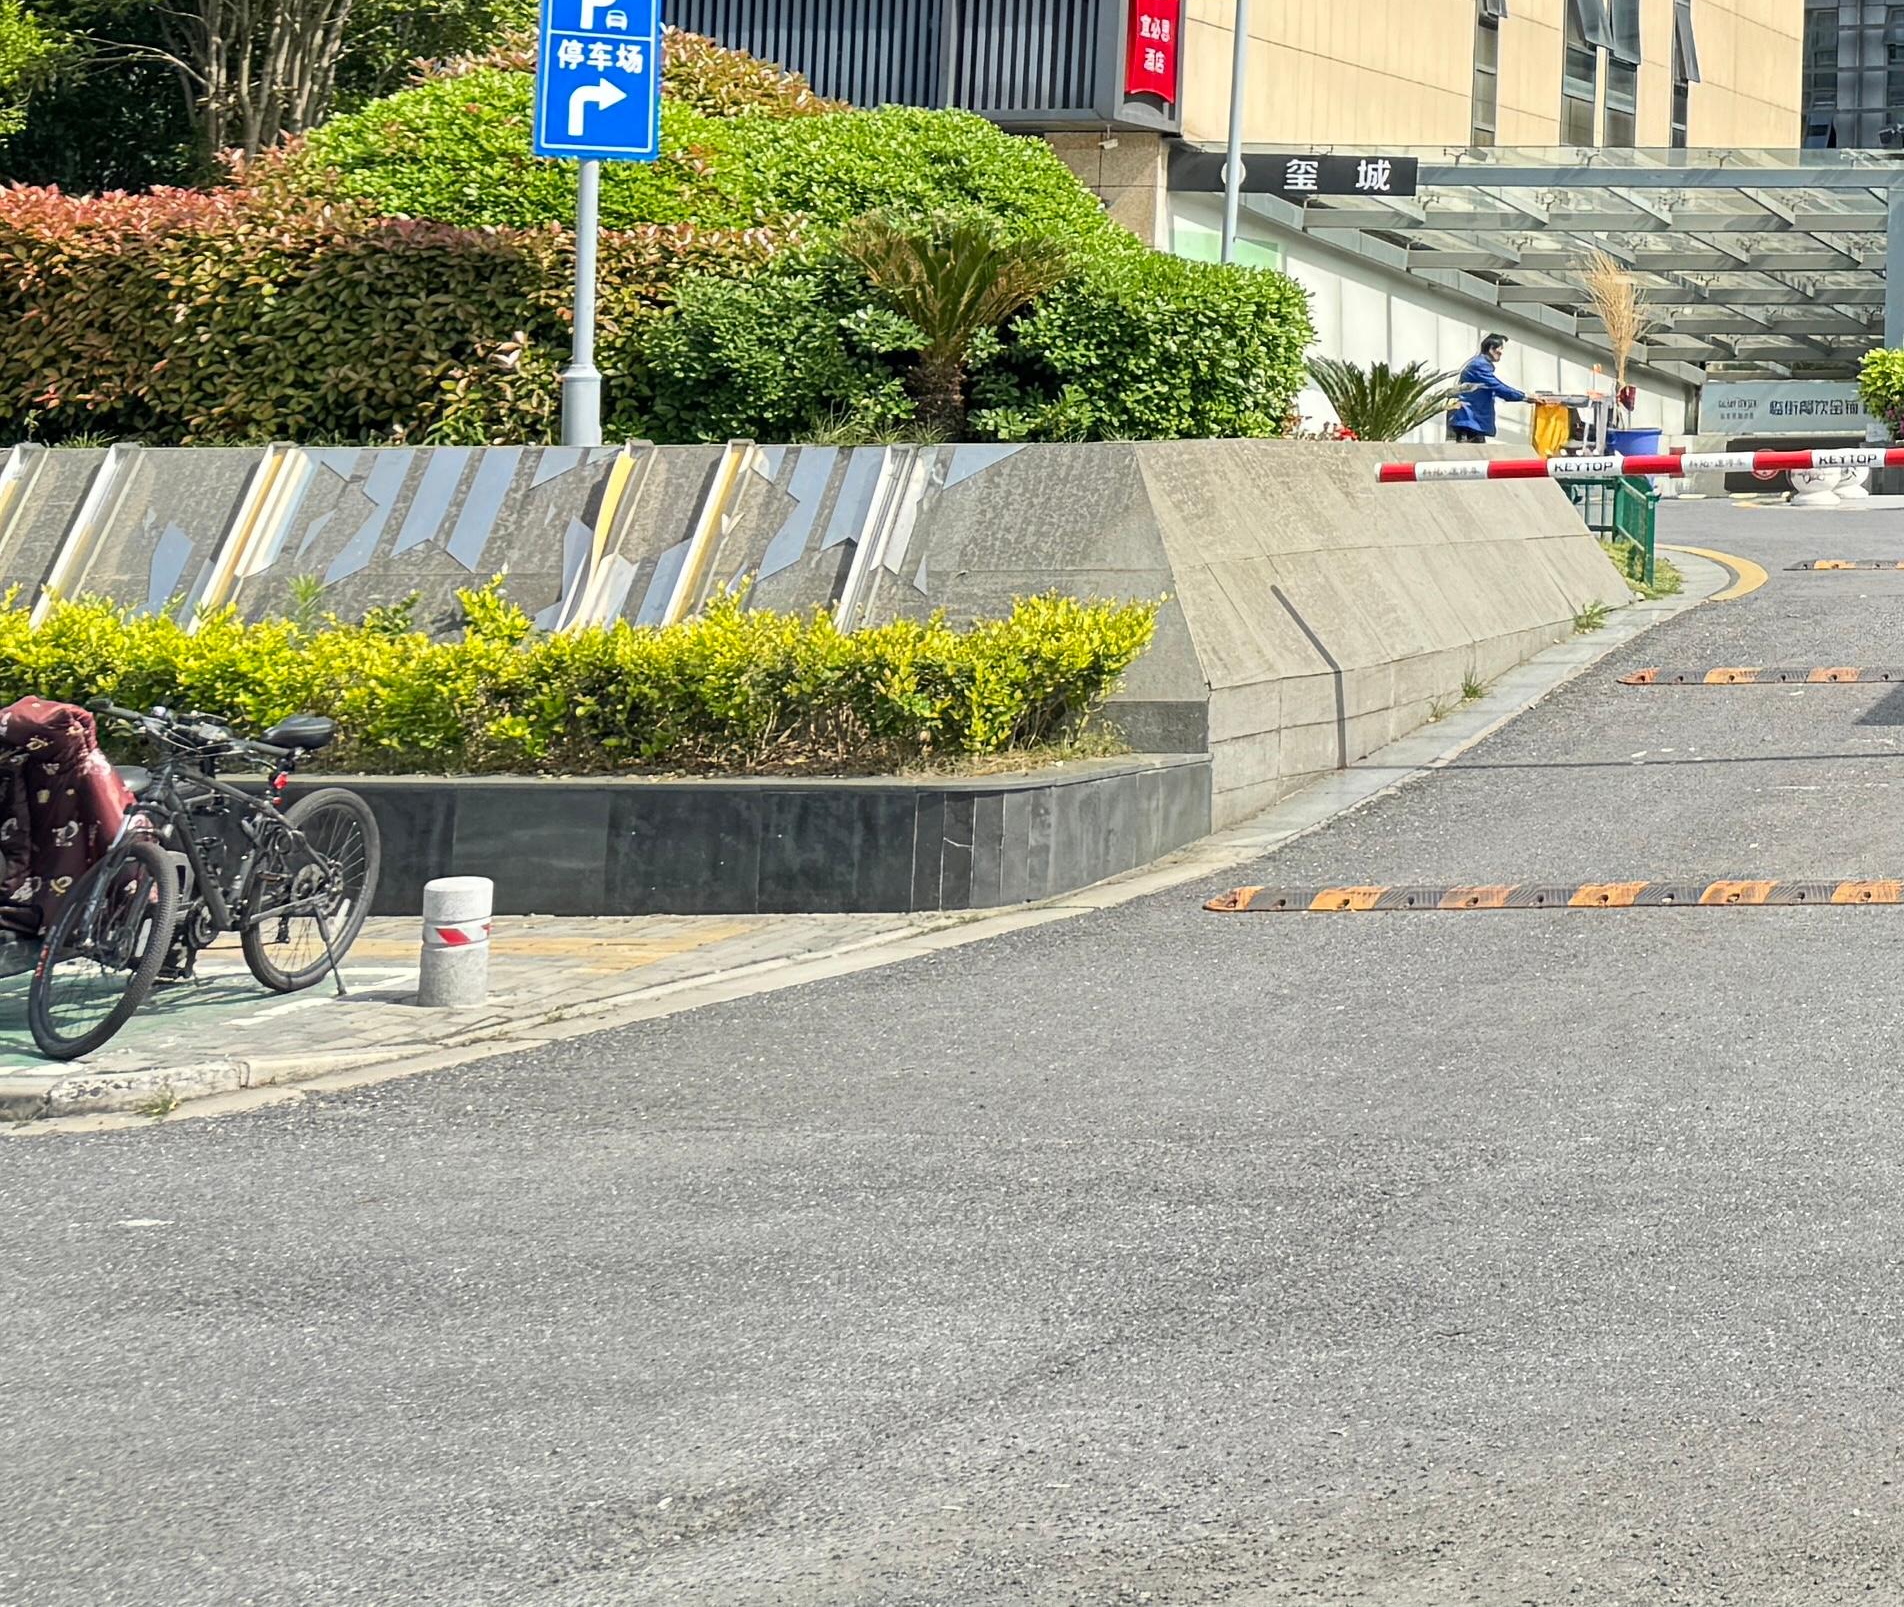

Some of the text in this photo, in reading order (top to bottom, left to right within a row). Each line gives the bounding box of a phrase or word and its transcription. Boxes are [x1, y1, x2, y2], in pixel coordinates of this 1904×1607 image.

[1140, 14, 1171, 43] 宜必思
[557, 39, 644, 74] 停车场
[1143, 47, 1166, 74] 酒店
[1283, 159, 1392, 191] 玺城
[1554, 460, 1614, 473] KEYTOP
[1819, 454, 1877, 466] KEYTOP
